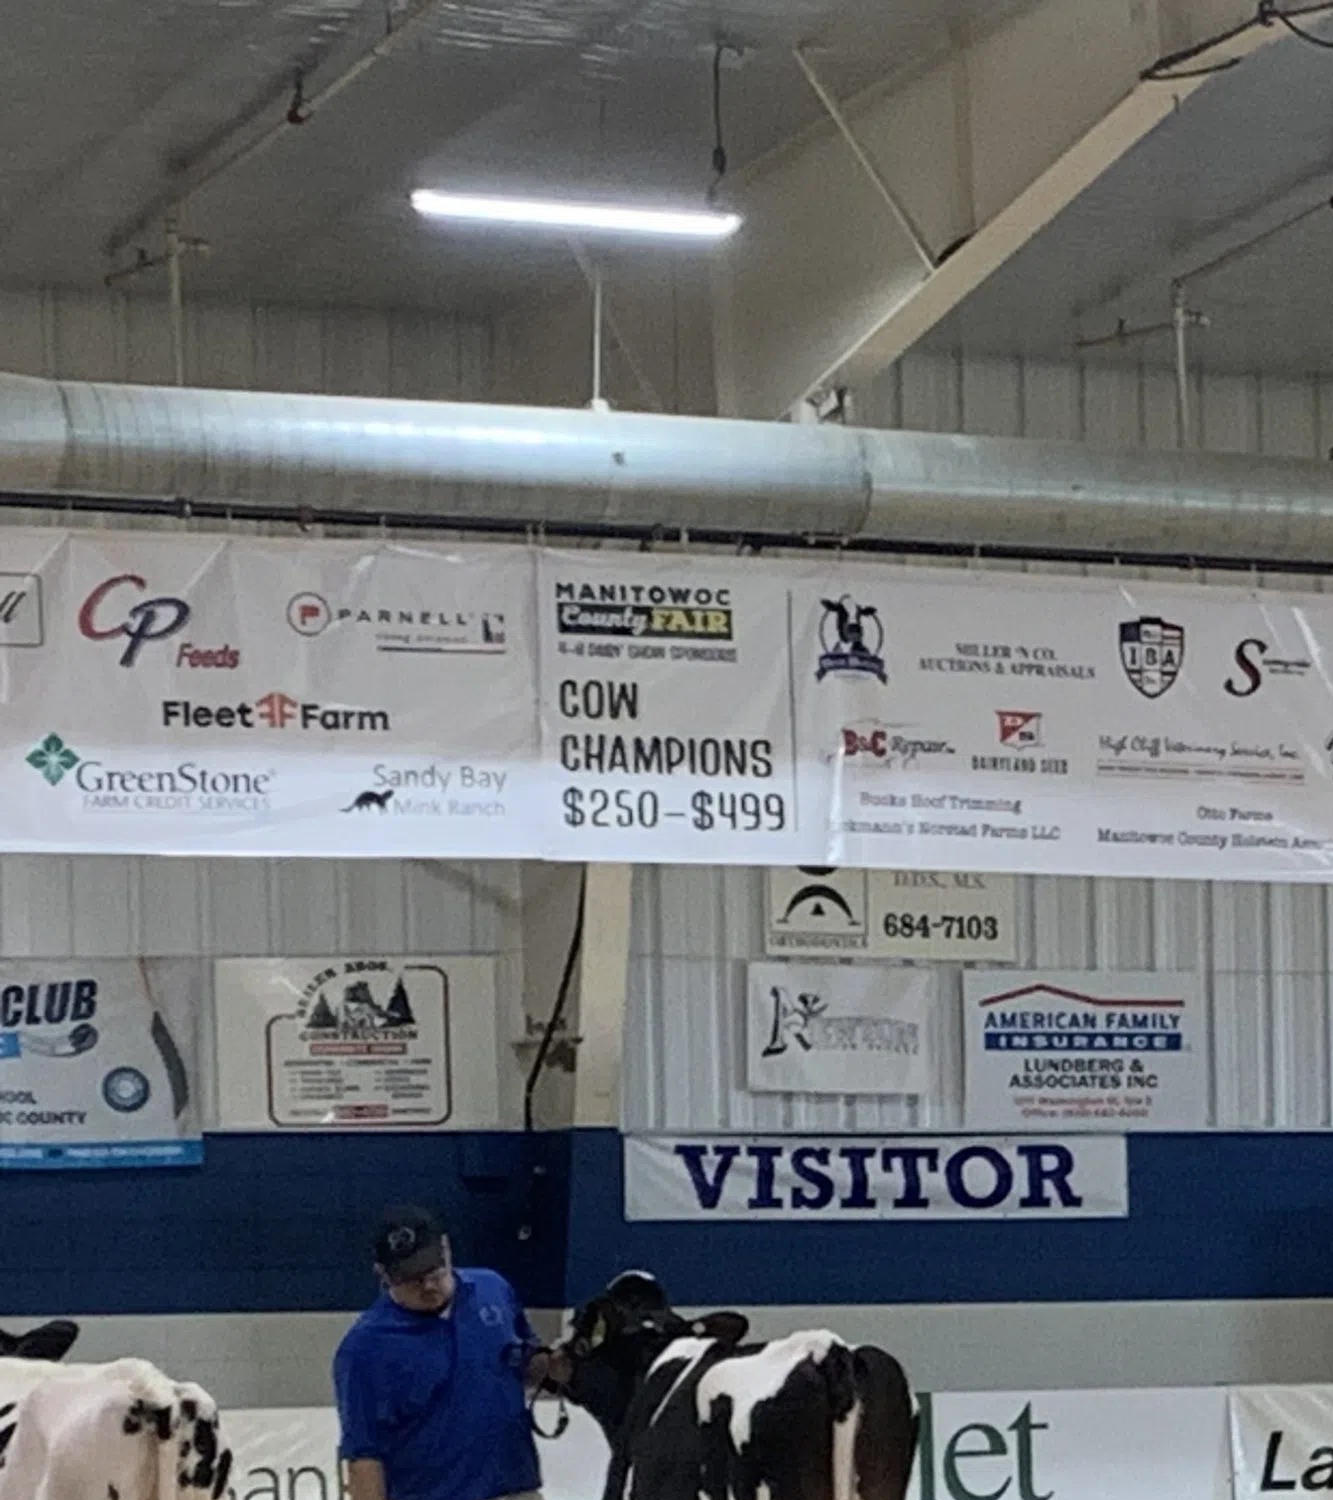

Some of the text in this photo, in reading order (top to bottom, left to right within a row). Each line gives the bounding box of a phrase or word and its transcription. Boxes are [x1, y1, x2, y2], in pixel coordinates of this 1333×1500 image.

[555, 583, 731, 606] MANITOWOC
[79, 574, 191, 669] CP
[337, 608, 468, 627] PARNELL
[561, 605, 729, 636] County FAIR
[176, 642, 240, 669] Feeds
[955, 643, 1011, 660] MILLER
[919, 658, 991, 676] AUCTIONS
[1011, 661, 1096, 680] APPRAISALS
[559, 679, 638, 720] COW
[163, 701, 254, 729] Fleet
[301, 703, 390, 731] Farm
[560, 734, 773, 778] CHAMPIONS
[971, 755, 1069, 774] DAIRYLAND SEED
[76, 761, 270, 794] GreenStone
[373, 763, 508, 793] Sandy Bay
[82, 796, 271, 811] FARM CREDIT SERVICES
[394, 799, 507, 817] Mink Ranch
[562, 786, 785, 831] $250-$499
[950, 795, 1022, 815] Trimming
[1229, 807, 1274, 822] Farms
[1031, 825, 1061, 840] LLC
[1097, 828, 1175, 844] Manitowoc
[1178, 831, 1227, 850] County
[883, 912, 999, 940] 684-7103
[1, 980, 98, 1027] CLUB
[984, 1011, 1181, 1030] AMERICAN FAMILY
[998, 1034, 1168, 1049] INSURANCE
[1024, 1058, 1145, 1073] LUNDBERG &
[1008, 1074, 1158, 1089] ASSOCIATES INC
[16, 1111, 87, 1124] COUNTY
[674, 1145, 1083, 1211] VISITOR
